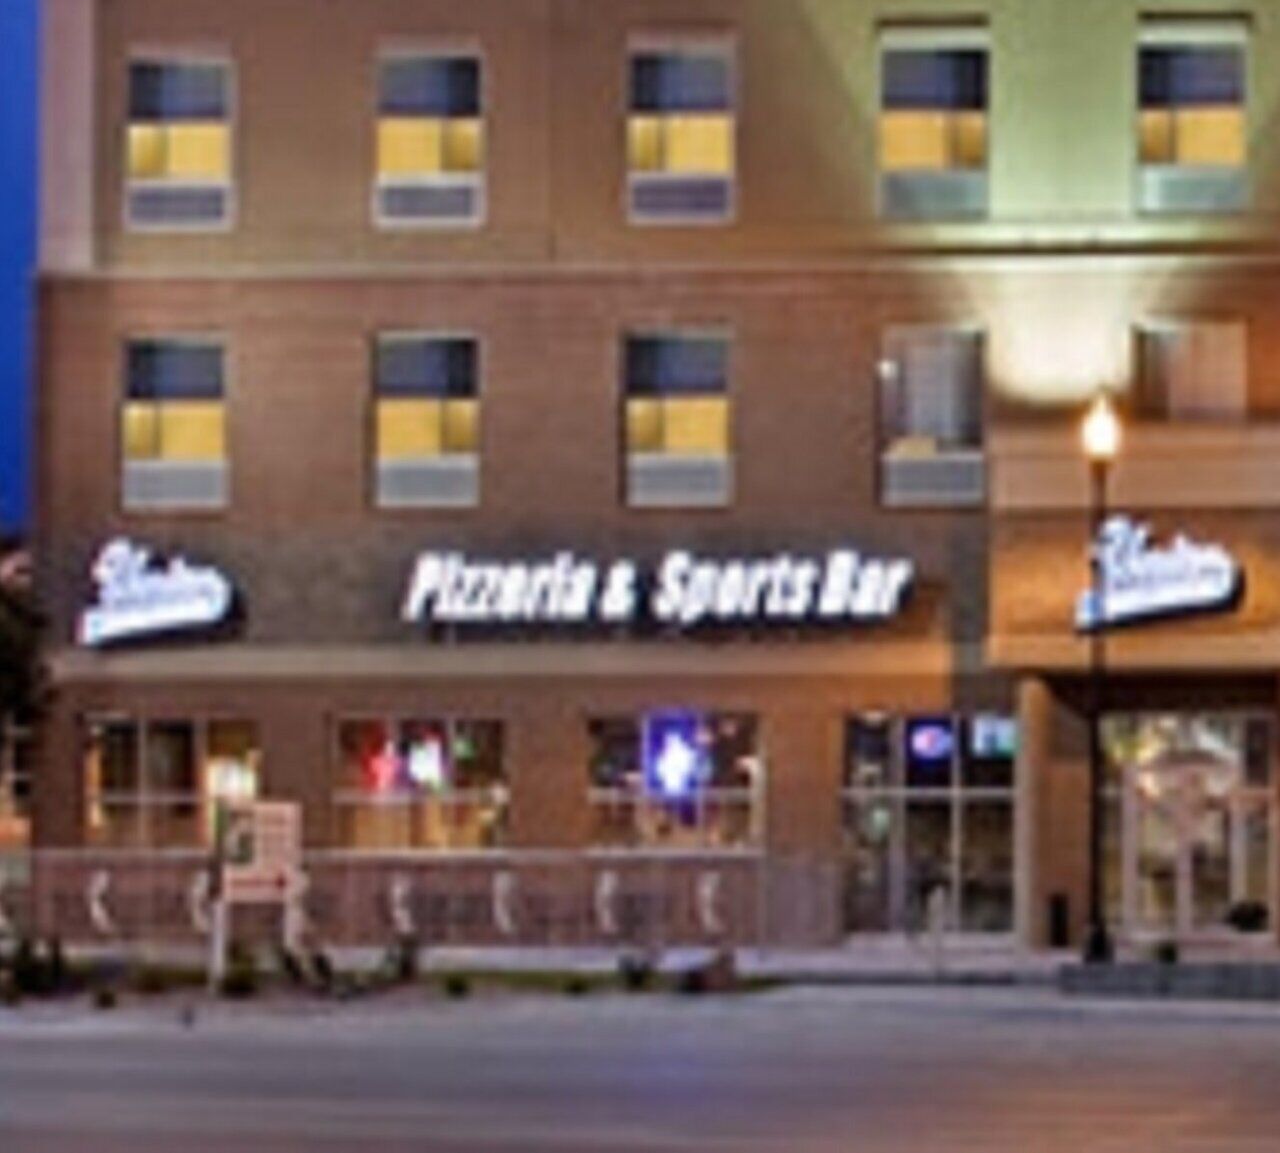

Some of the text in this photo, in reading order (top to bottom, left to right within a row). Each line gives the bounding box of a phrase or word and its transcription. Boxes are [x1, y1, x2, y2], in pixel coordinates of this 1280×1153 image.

[403, 550, 914, 622] Pizzeria & Sports Bar
